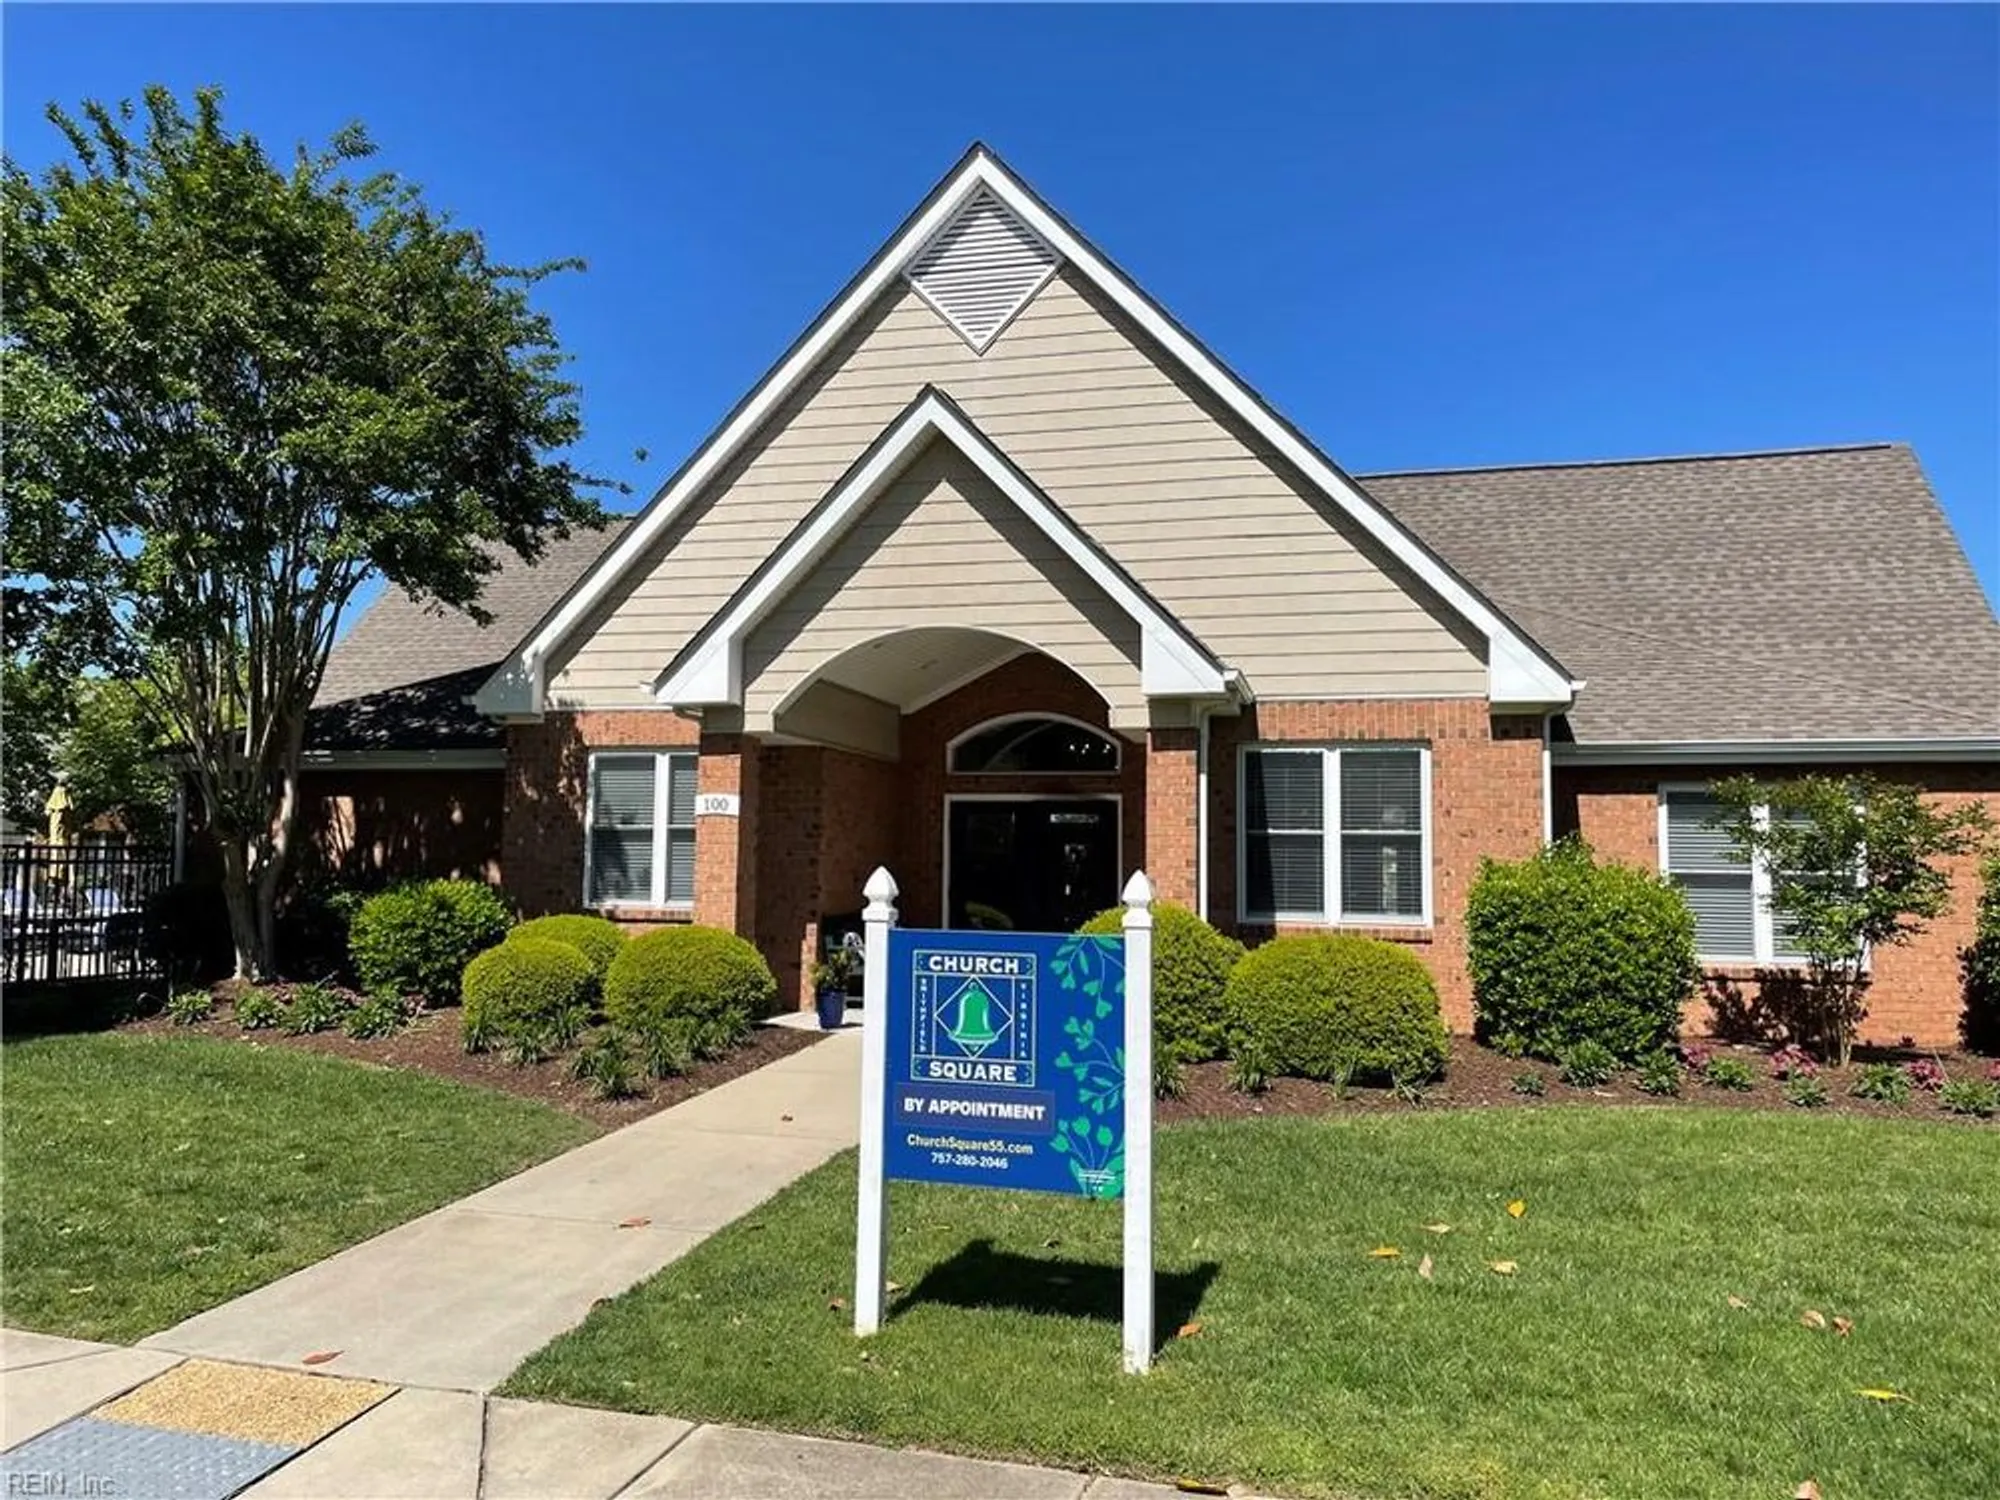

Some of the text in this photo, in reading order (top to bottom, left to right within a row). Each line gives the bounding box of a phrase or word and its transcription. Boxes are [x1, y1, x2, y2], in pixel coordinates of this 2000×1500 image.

[704, 797, 729, 811] 100
[929, 956, 1019, 974] CHURCH
[929, 1061, 1017, 1081] SQUARE
[903, 1097, 1045, 1121] BY APPOINTMENT
[907, 1133, 1034, 1155] ChurchSquare55.com
[930, 1152, 1009, 1169] 757-280-2046
